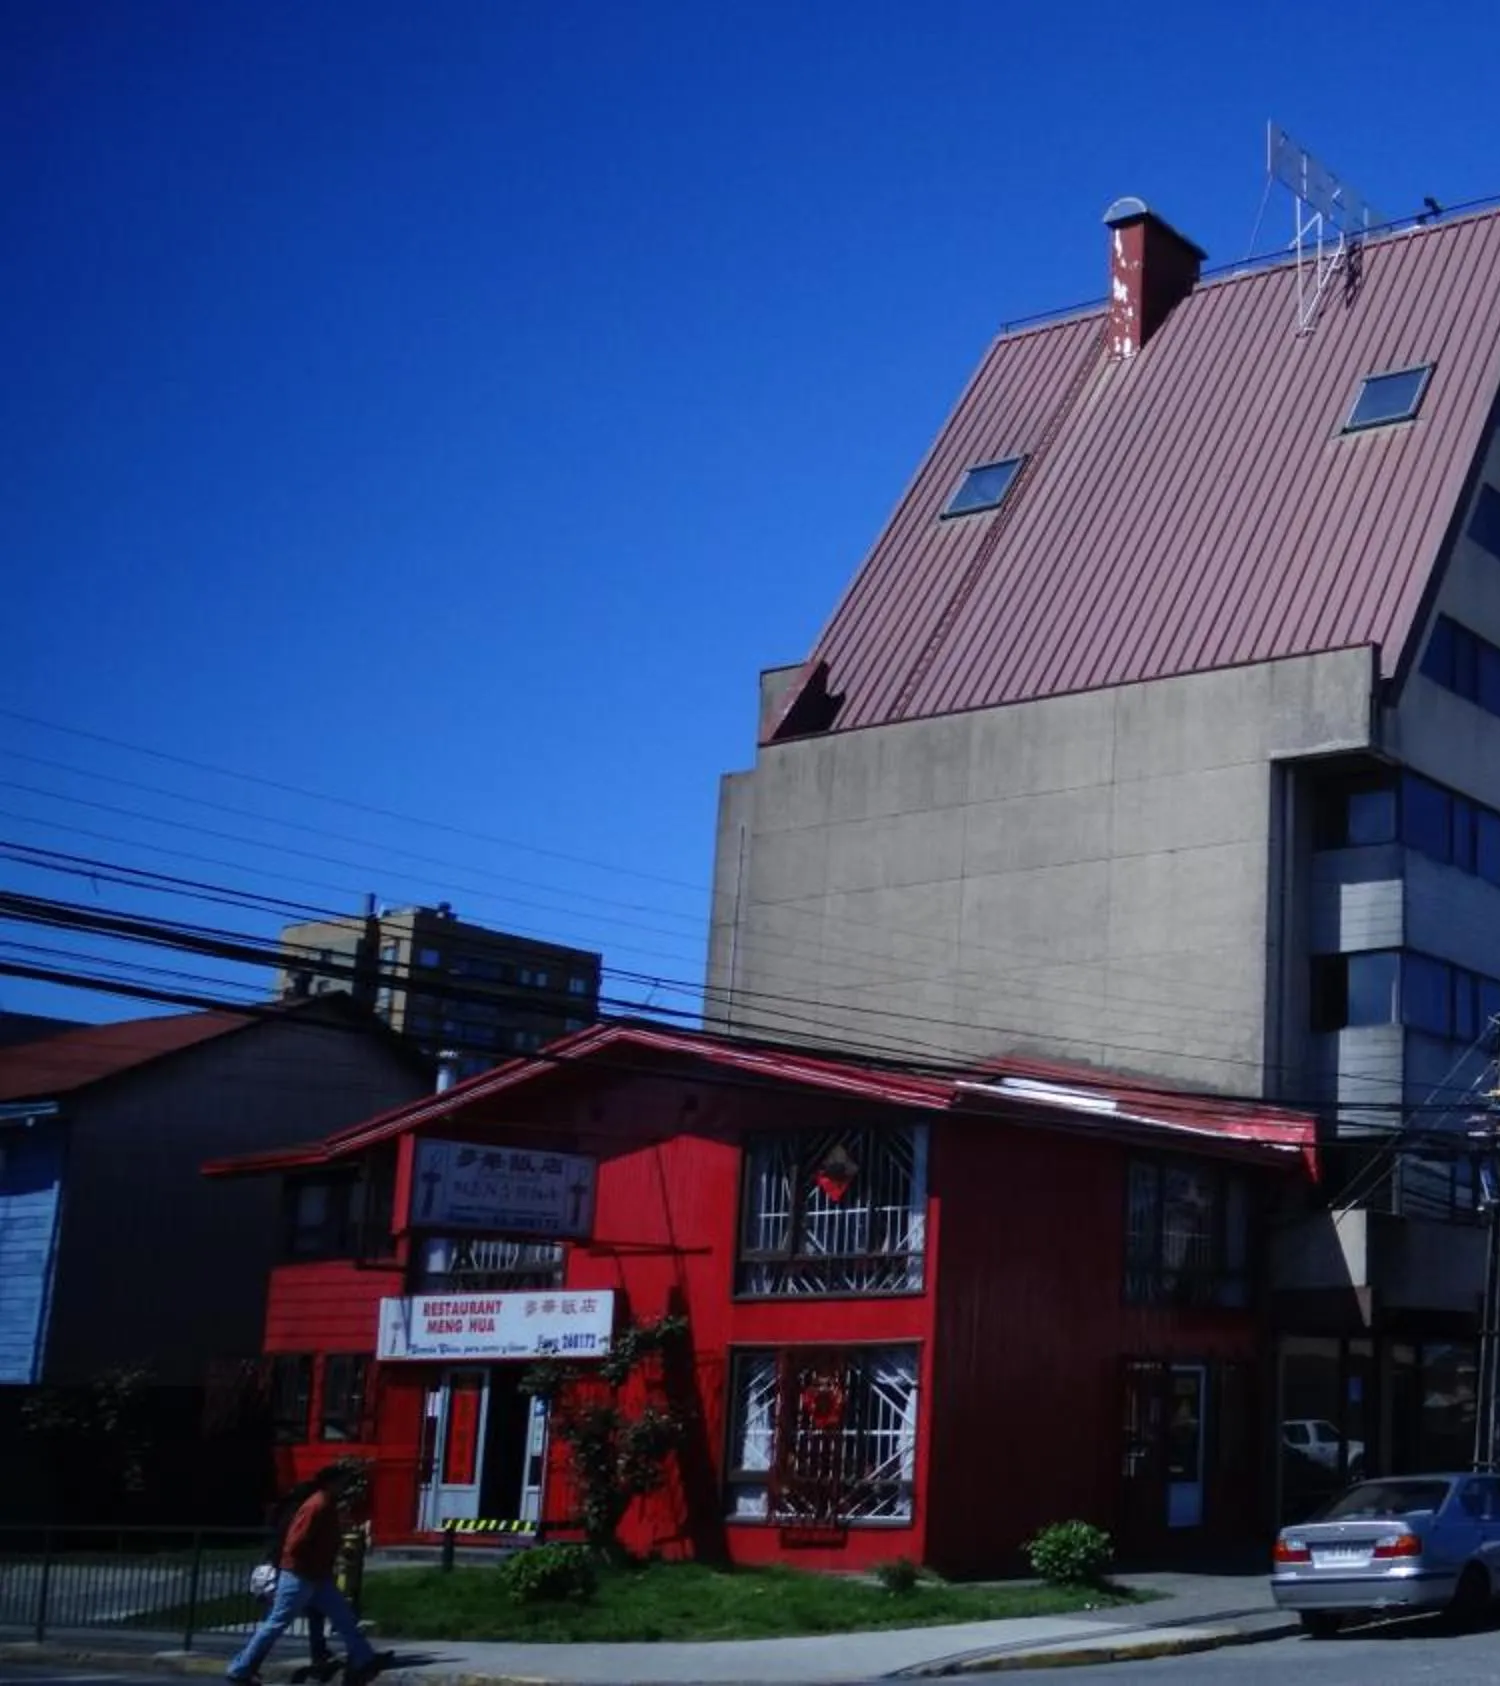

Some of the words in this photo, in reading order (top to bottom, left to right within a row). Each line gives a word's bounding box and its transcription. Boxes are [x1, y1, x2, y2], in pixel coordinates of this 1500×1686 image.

[423, 1300, 503, 1317] RESTAURANT
[426, 1319, 463, 1333] MENG
[468, 1318, 495, 1333] HUA
